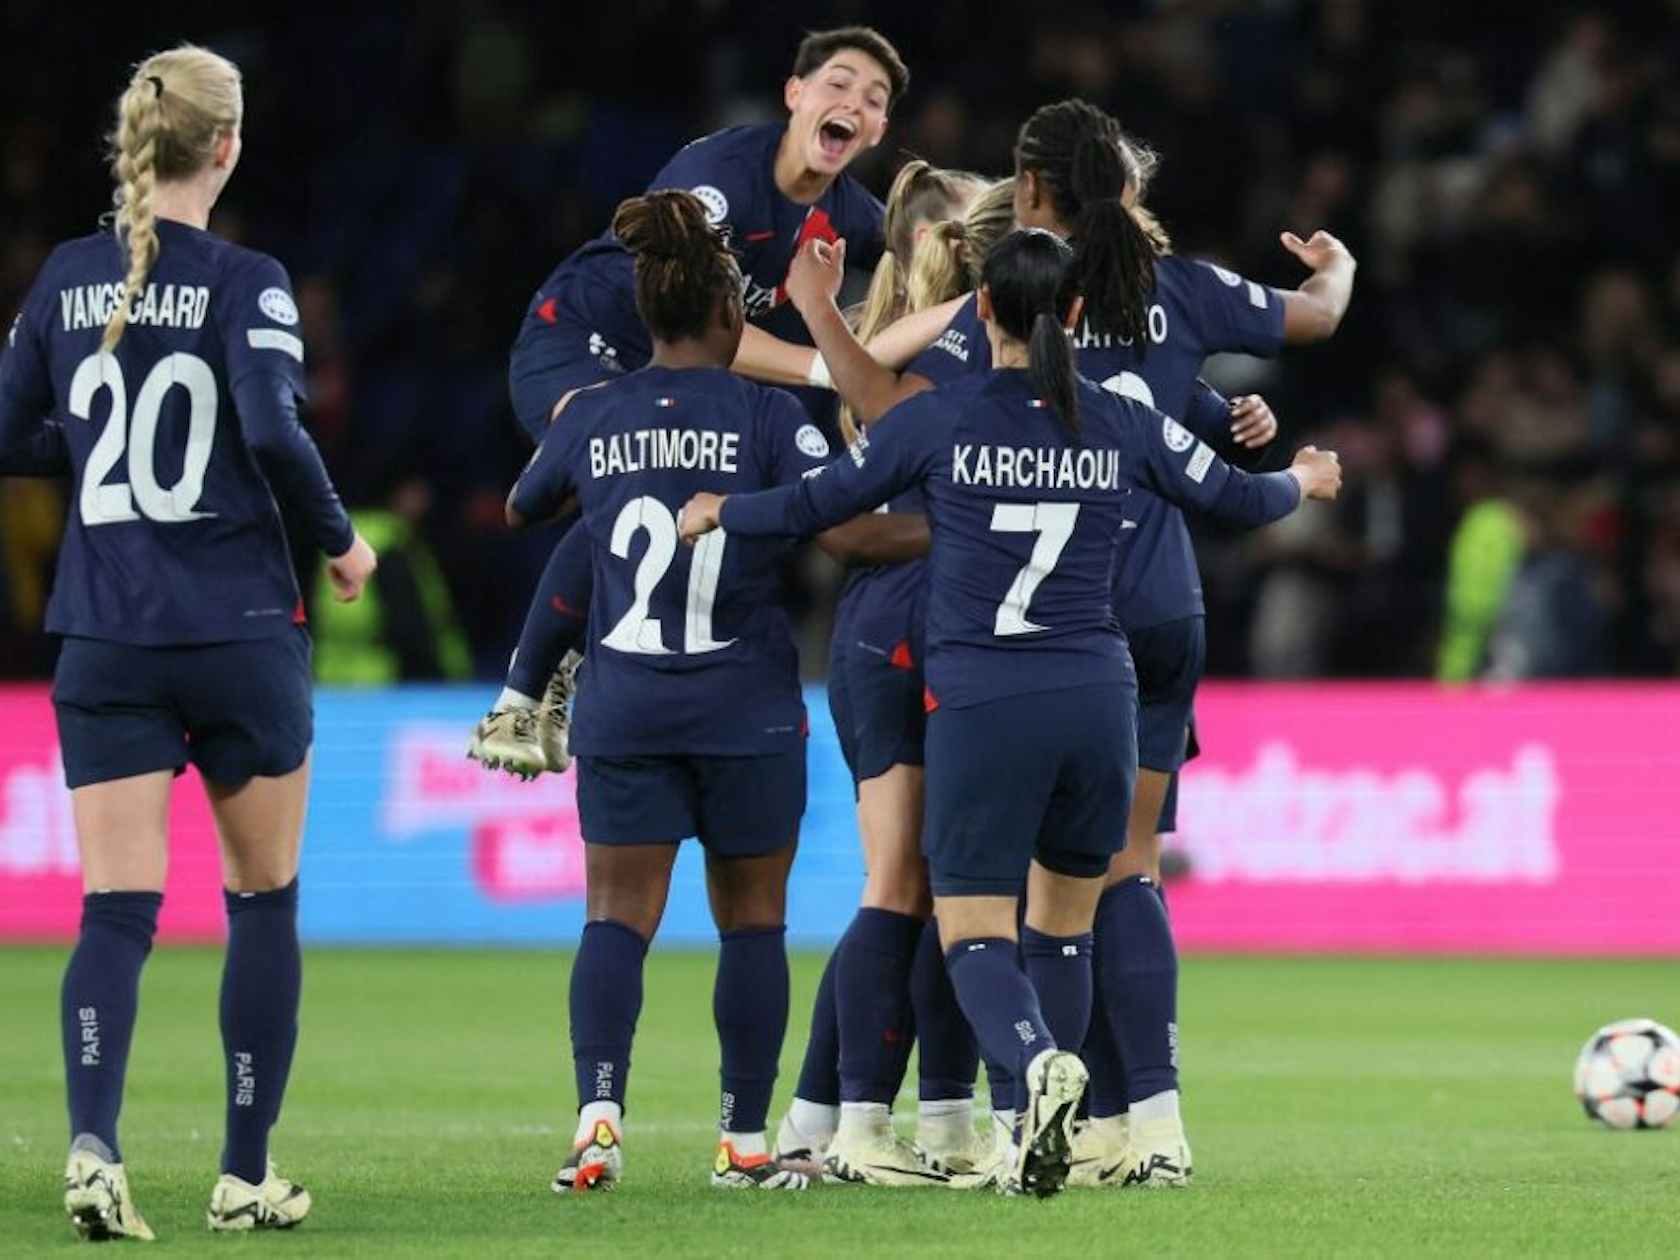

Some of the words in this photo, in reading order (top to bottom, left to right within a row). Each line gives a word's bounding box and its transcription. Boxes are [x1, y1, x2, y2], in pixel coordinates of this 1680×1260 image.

[68, 351, 218, 526] 20
[589, 428, 740, 479] BALTIMORE
[952, 445, 1120, 490] KARCHAOUI
[600, 495, 740, 655] 21
[990, 501, 1081, 637] 7
[79, 1006, 100, 1065] PARIS
[235, 1052, 256, 1106] PARIS
